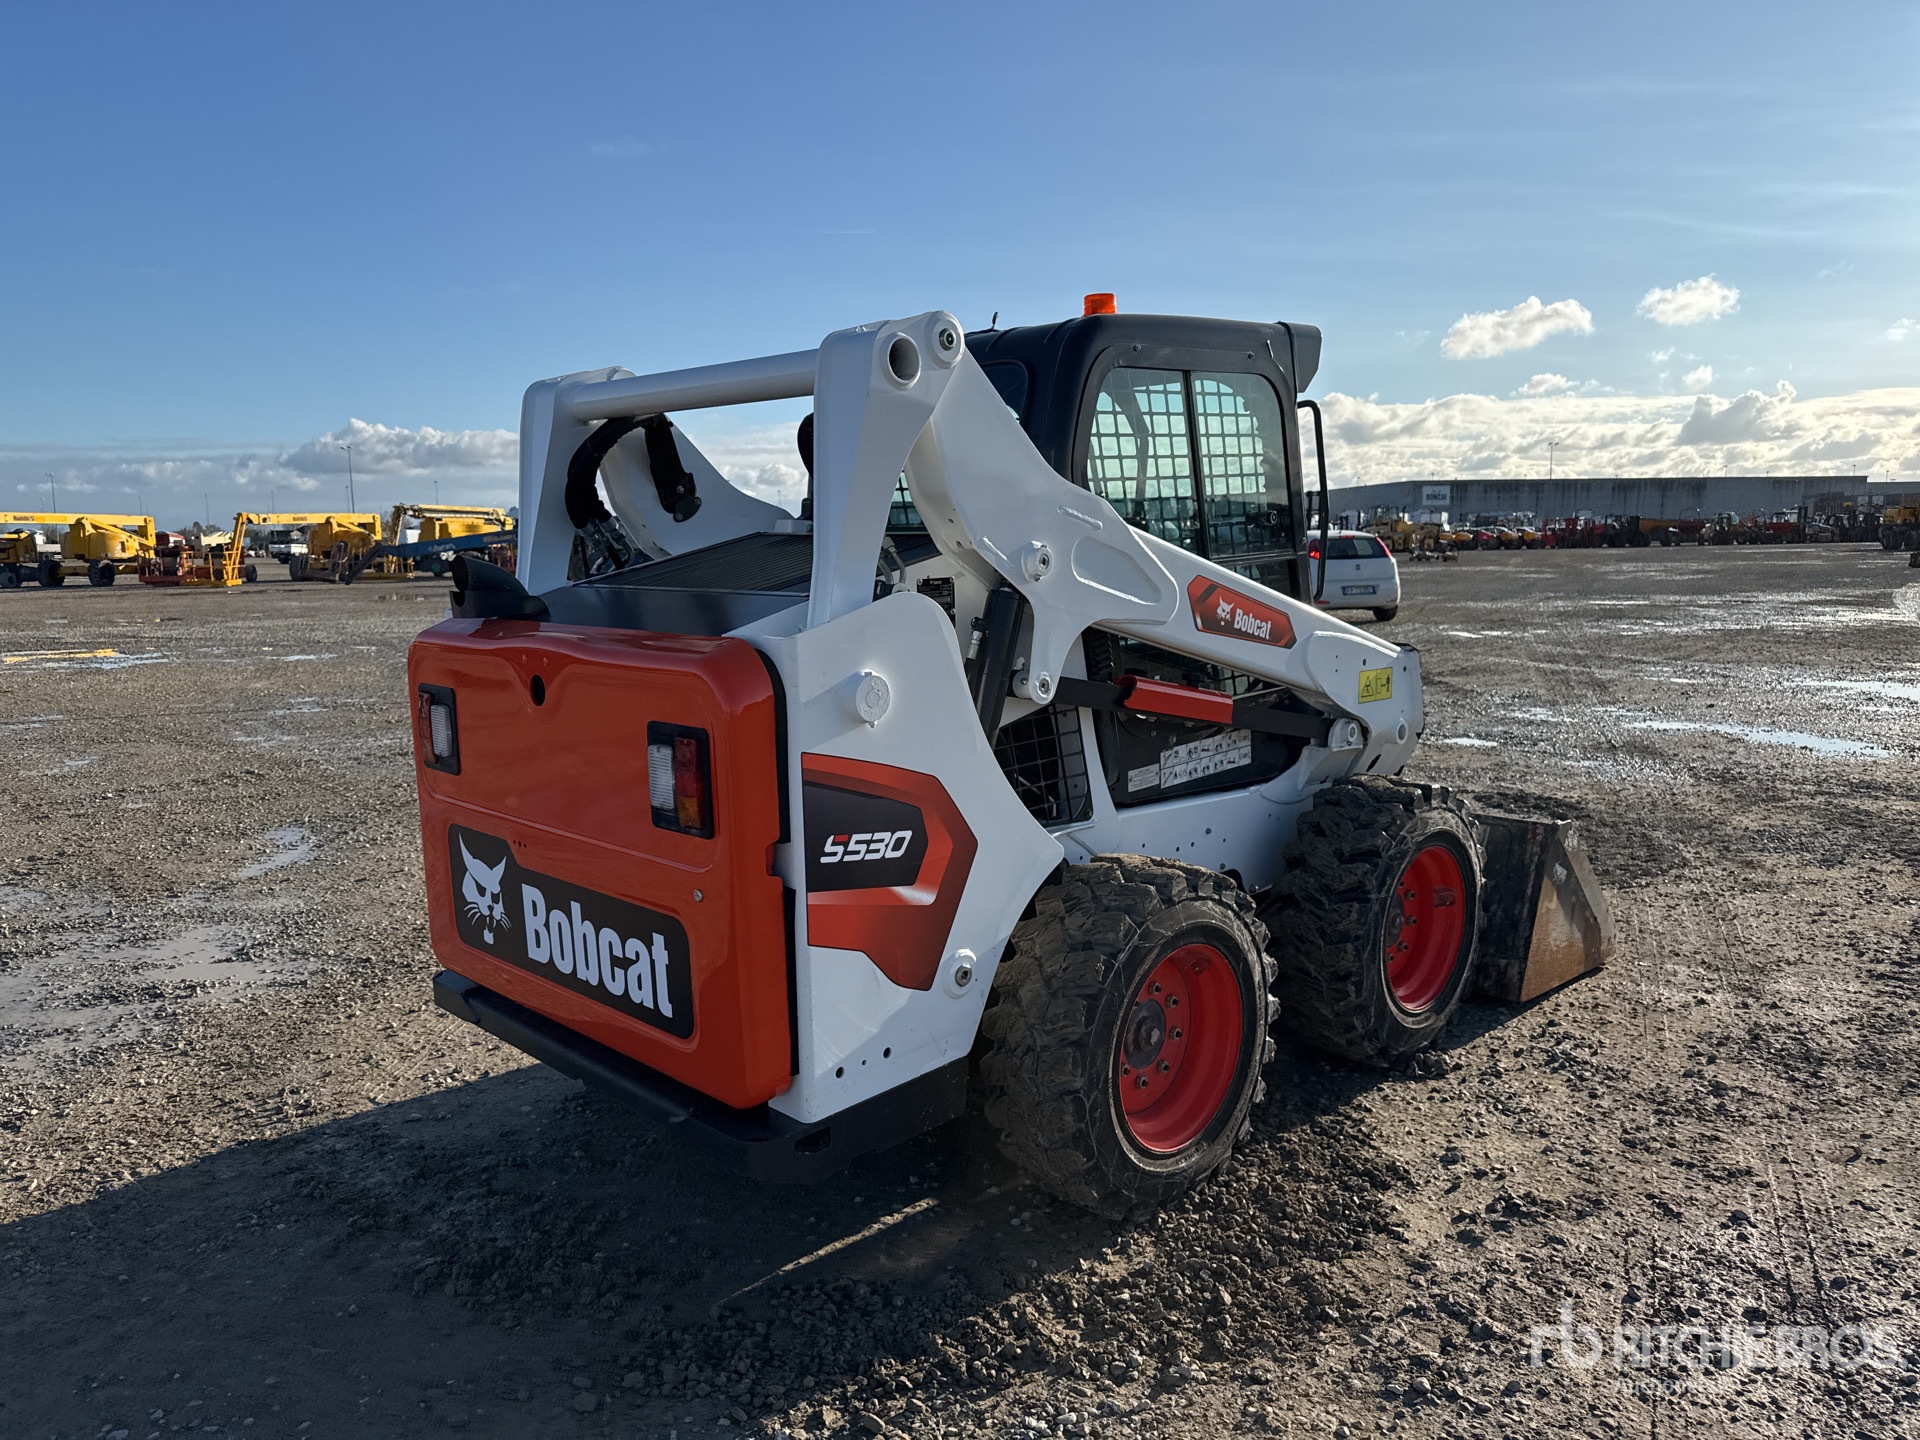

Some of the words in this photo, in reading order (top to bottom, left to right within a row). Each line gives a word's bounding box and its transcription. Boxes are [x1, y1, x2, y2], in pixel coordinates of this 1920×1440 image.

[1234, 608, 1272, 640] Bobcat
[820, 830, 912, 863] S530
[521, 883, 673, 1019] Bobcat
